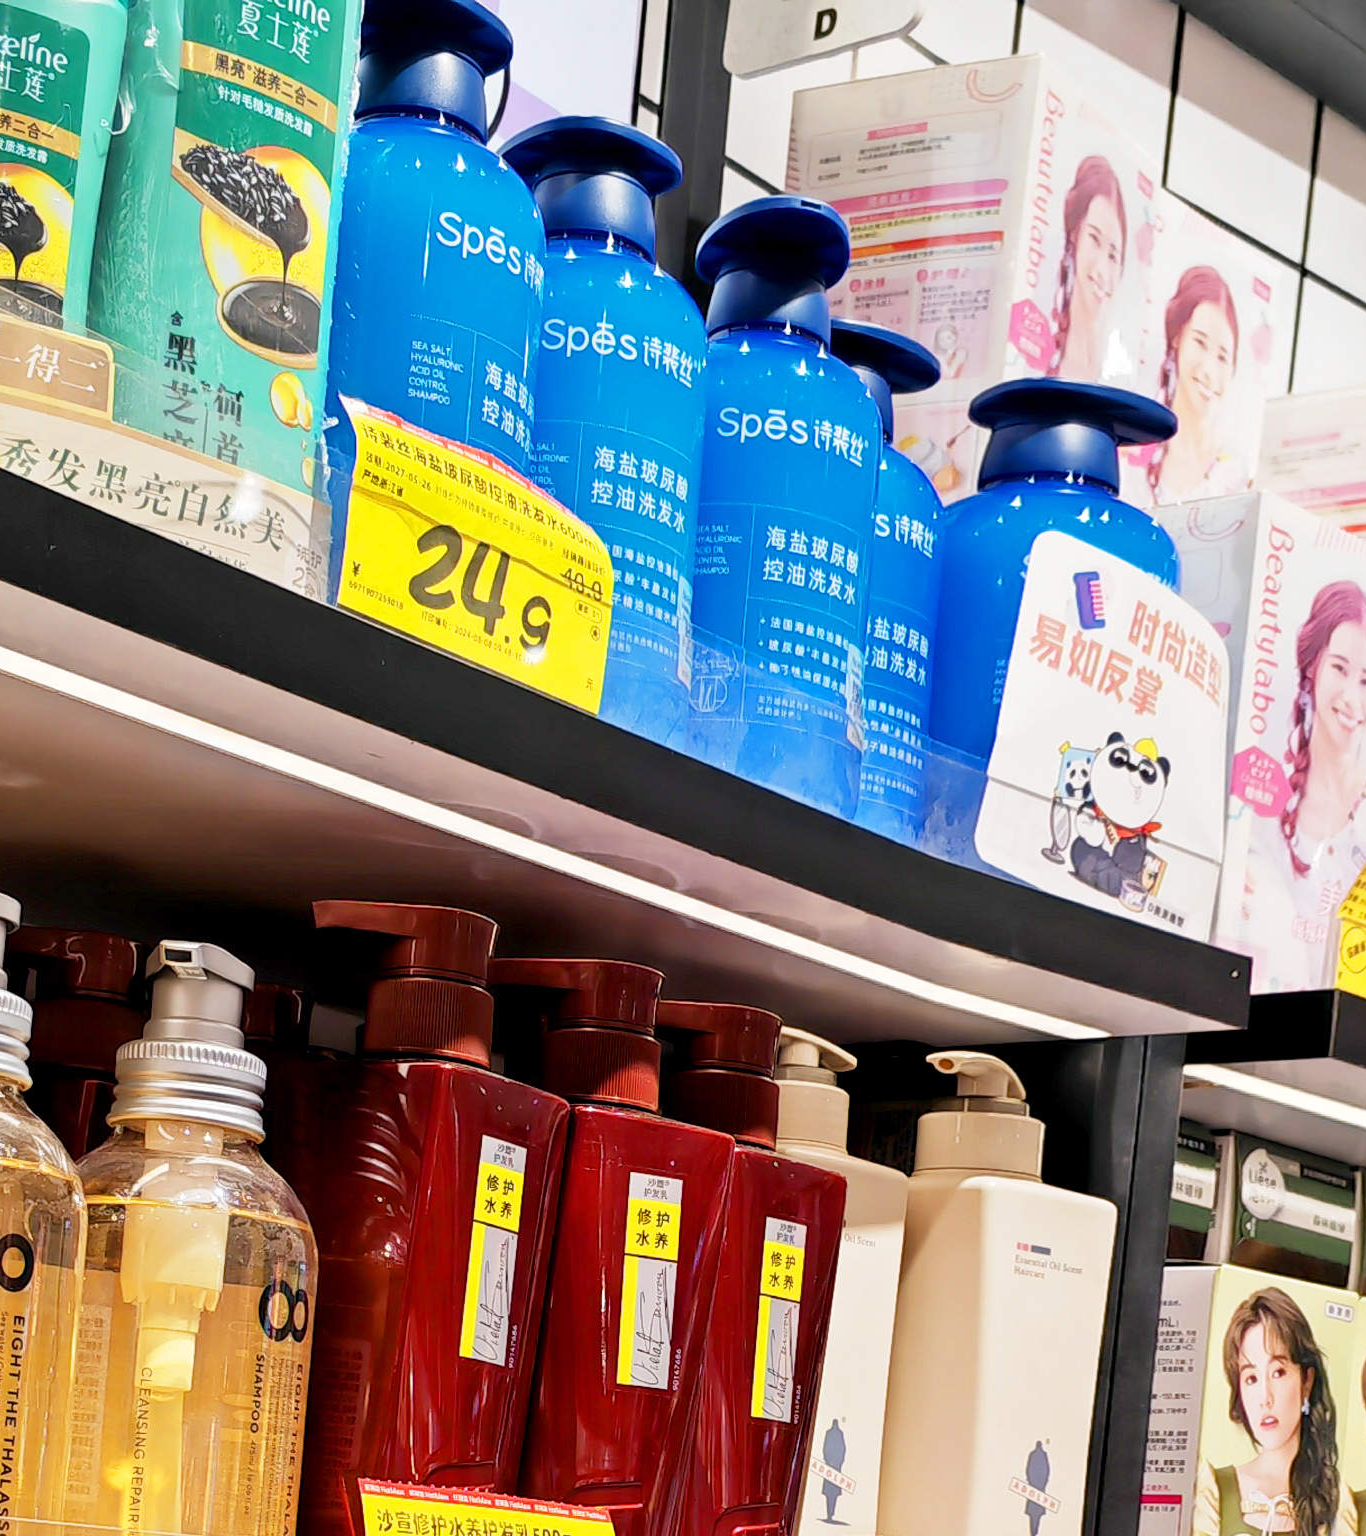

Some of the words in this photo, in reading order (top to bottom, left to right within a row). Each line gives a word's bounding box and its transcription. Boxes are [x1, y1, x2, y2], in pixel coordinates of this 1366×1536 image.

[814, 8, 838, 40] D
[410, 352, 465, 374] HYALURONIC
[407, 389, 452, 405] SHAMPOO
[408, 378, 450, 393] CONTROL
[594, 445, 688, 504] 海盐玻尿酸
[590, 484, 686, 535] 控油洗发水
[766, 526, 859, 577] 海盐玻尿酸
[408, 522, 553, 655] 24.9
[762, 560, 856, 607] 控油洗发水
[1248, 522, 1296, 738] Beautylabo
[1028, 613, 1164, 718] 易如反掌
[485, 1173, 516, 1197] 修护
[483, 1196, 513, 1220] 水养
[637, 1207, 672, 1229] 修护
[635, 1228, 670, 1250] 水养
[770, 1250, 797, 1272] 修护
[768, 1271, 795, 1292] 水养
[7, 1314, 26, 1382] EIGHT
[4, 1388, 20, 1429] THE
[137, 1365, 153, 1454] CLEANSING
[249, 1353, 266, 1435] SHAMPOO
[130, 1464, 145, 1530] REPAIR
